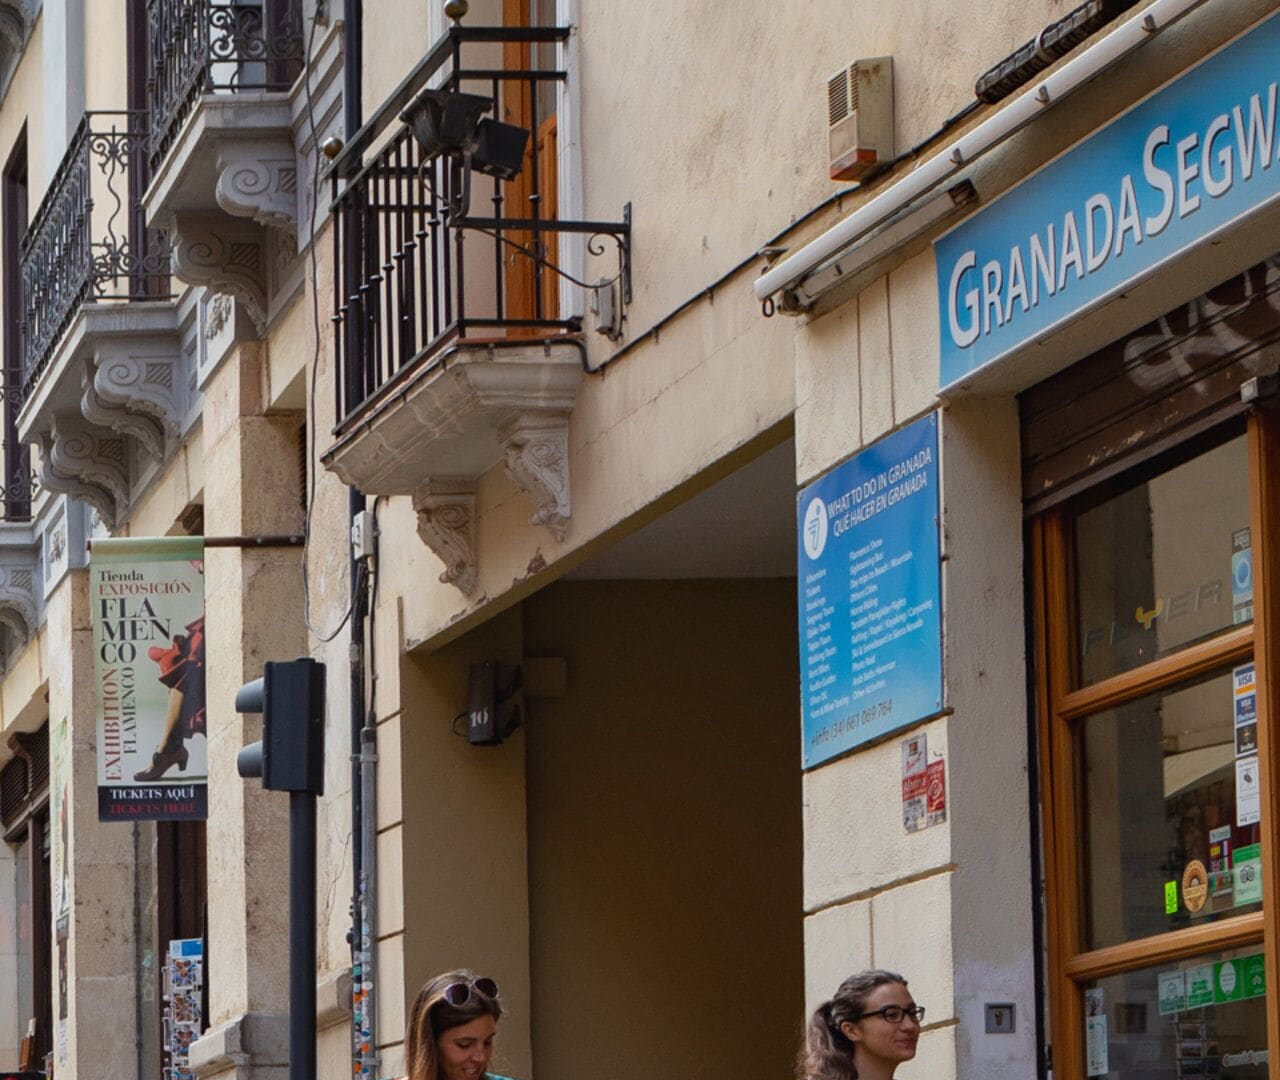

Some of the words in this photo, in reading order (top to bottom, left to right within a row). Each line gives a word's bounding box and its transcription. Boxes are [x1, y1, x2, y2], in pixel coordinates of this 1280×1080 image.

[947, 81, 1280, 349] GRANADASEGW
[827, 494, 848, 518] WHAT
[851, 486, 862, 505] TO
[864, 478, 876, 497] DO
[878, 473, 886, 490] IN
[888, 447, 931, 484] GRANADA
[833, 512, 849, 537] QUÉ
[850, 501, 874, 526] HACER
[877, 494, 887, 511] EN
[888, 471, 927, 505] GRANADA
[98, 570, 144, 582] Tienda
[99, 579, 191, 596] EXPOSICIÓN
[100, 597, 156, 618] FLA
[100, 618, 170, 642] MEN
[101, 642, 137, 665] CO
[122, 667, 137, 754] FLAMENCO
[104, 668, 122, 781] EXHIBITION
[110, 788, 162, 800] TICKETS
[164, 785, 195, 800] AQUÍ
